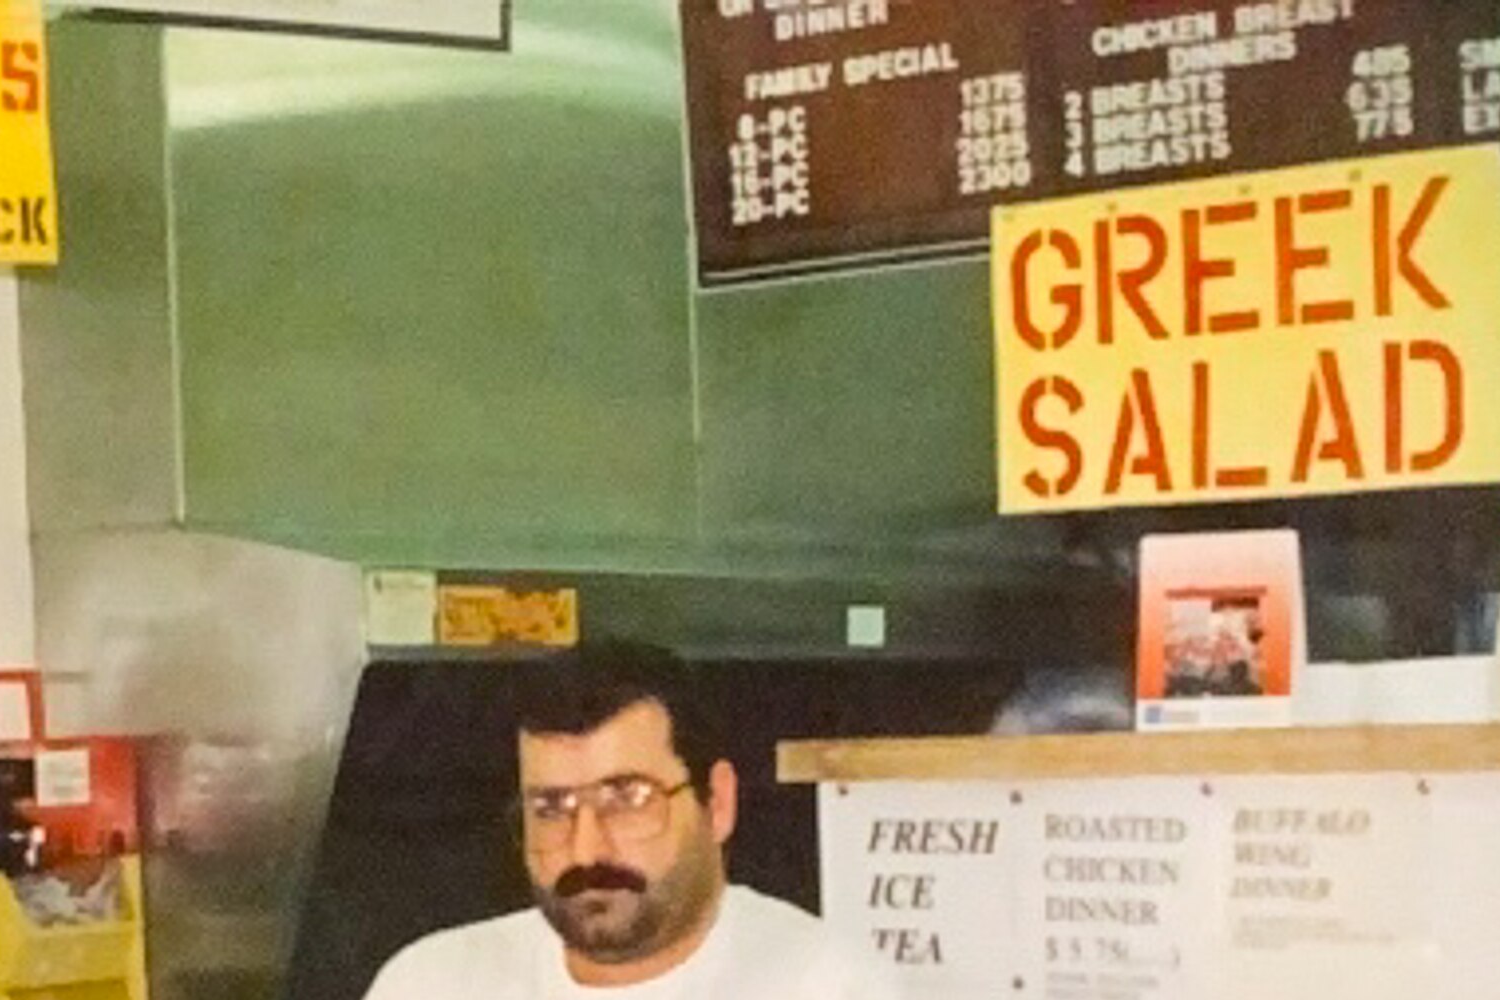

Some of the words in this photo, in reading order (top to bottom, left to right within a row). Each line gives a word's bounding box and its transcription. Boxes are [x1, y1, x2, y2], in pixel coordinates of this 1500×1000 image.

[775, 0, 888, 41] DINNER
[745, 62, 833, 100] FAMILY
[843, 43, 959, 86] SPECIAL
[960, 72, 1026, 106] 1375
[1064, 90, 1082, 119] 2
[1091, 71, 1226, 115] BREASTS
[1092, 102, 1228, 144] BREASTS
[1064, 150, 1084, 177] 4
[1094, 130, 1232, 174] BREASTS
[958, 161, 1032, 195] 2300
[1009, 174, 1454, 352] GREEK
[1017, 338, 1466, 499] SALAD
[866, 817, 1000, 855] FRESH
[1043, 812, 1189, 844] ROASTED
[1232, 808, 1372, 836] BUFFALO
[1043, 855, 1181, 886] CHICKEN
[1233, 841, 1312, 869] WING
[867, 873, 937, 911] ICE
[1229, 876, 1332, 902] DINNER
[1044, 895, 1160, 927] DINNER
[870, 927, 944, 966] TEA
